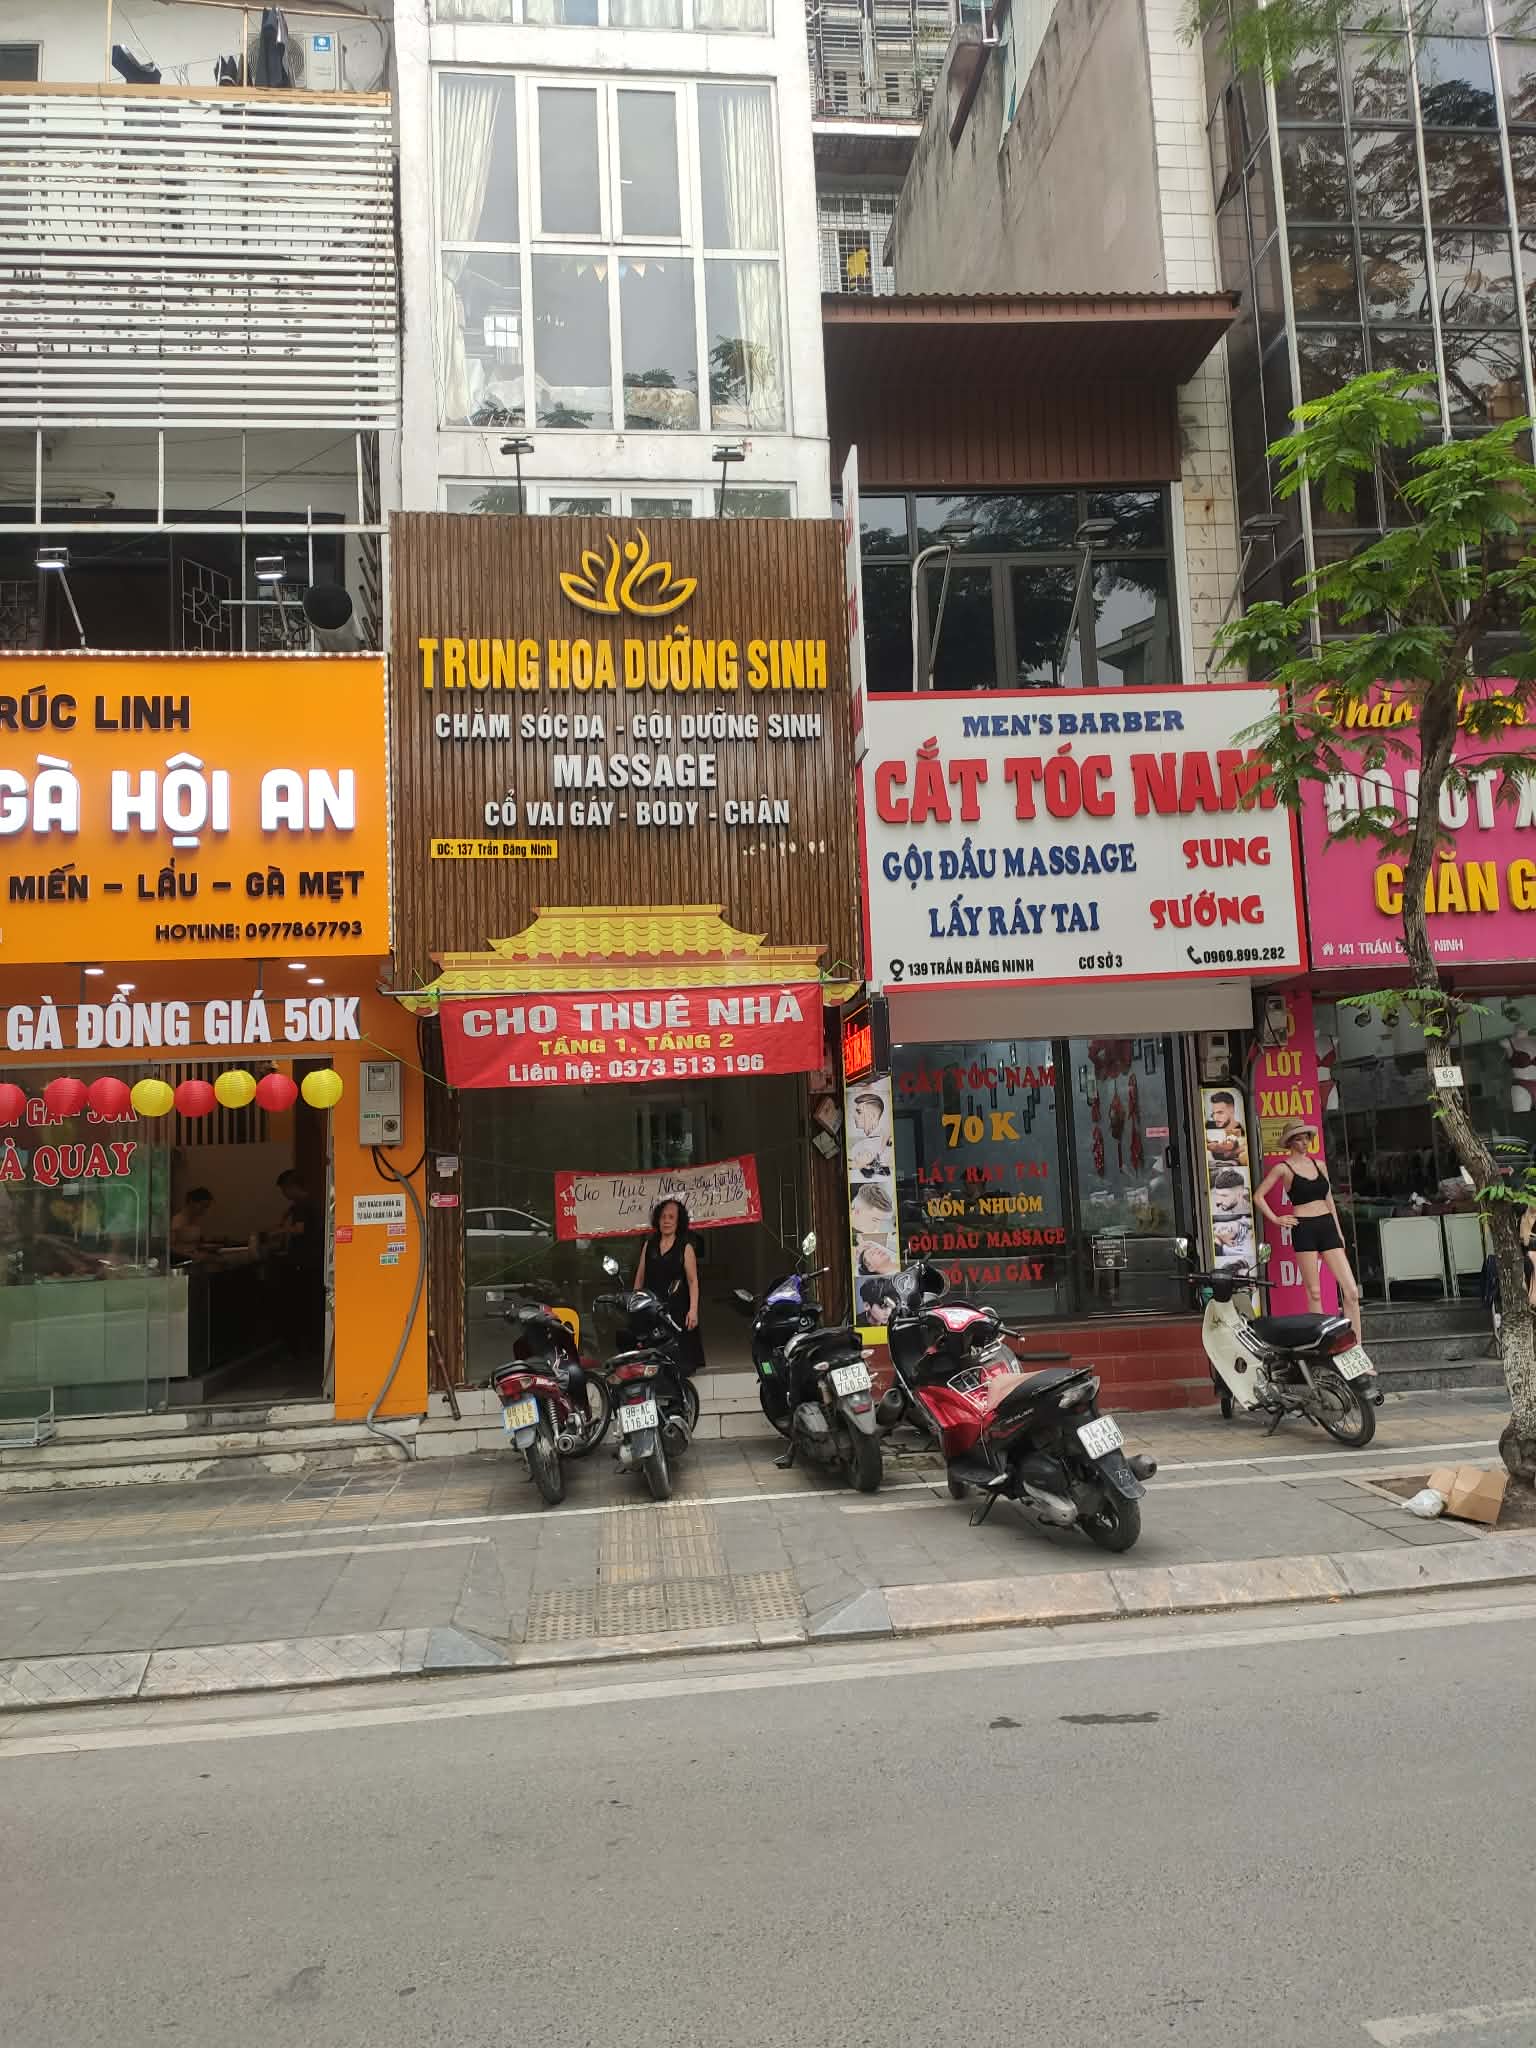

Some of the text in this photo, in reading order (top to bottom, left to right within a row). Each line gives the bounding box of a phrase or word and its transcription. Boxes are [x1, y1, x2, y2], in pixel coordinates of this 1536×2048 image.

[419, 625, 827, 693] TRUNG HOA DƯỠNG SINH
[95, 695, 190, 730] LINH
[435, 707, 511, 741] CHĂM
[520, 707, 569, 741] SÓC
[574, 714, 606, 741] DA
[632, 708, 672, 744] GỘI
[680, 706, 759, 741] DƯỠNG
[767, 713, 822, 740] SINH
[963, 710, 1184, 738] MEN'S BARBER
[553, 753, 717, 790] MASSAGE
[875, 736, 1279, 823] CẮT TÓC NAM
[111, 752, 230, 848] HỘI
[261, 769, 356, 832] AN
[485, 788, 517, 826] CỔ
[526, 802, 564, 826] VAI
[570, 796, 615, 826] GÁY
[636, 801, 699, 826] BODY
[725, 793, 790, 826] CHÂN
[457, 843, 474, 855] 137
[882, 837, 1137, 890] GỘI ĐẦU MASSAGE
[1182, 836, 1271, 869] SUNG
[9, 863, 90, 901] MIẾN
[138, 856, 198, 899] LẨU
[246, 865, 285, 898] GÀ
[299, 870, 365, 903] MẸT
[1374, 850, 1500, 915] CĂN
[929, 894, 1100, 937] LẤY RÁY TAI
[1149, 888, 1264, 930] SƯỚNG
[155, 920, 363, 941] HOTLINE: 0977867793
[1434, 939, 1464, 952] NINH
[908, 963, 929, 976] 139
[930, 956, 963, 975] TRẦN
[1002, 958, 1034, 972] NINH
[1115, 954, 1123, 968] 3
[7, 986, 361, 1051] GÀ ĐỒNG GIÁ 50K
[462, 990, 804, 1037] CHO THUÊ NHÀ
[719, 1033, 735, 1048] 2
[508, 1054, 765, 1083] Liên hệ: 0373 513 196
[1004, 1065, 1057, 1088] NAM
[1265, 1046, 1303, 1077] LÓT
[1259, 1081, 1314, 1117] XUẤT
[33, 1142, 137, 1186] QUAY
[1014, 1160, 1049, 1180] TAI
[979, 1192, 1042, 1217] NHUỘM
[986, 1226, 1067, 1248] MASSAGE
[967, 1264, 1001, 1283] VAI
